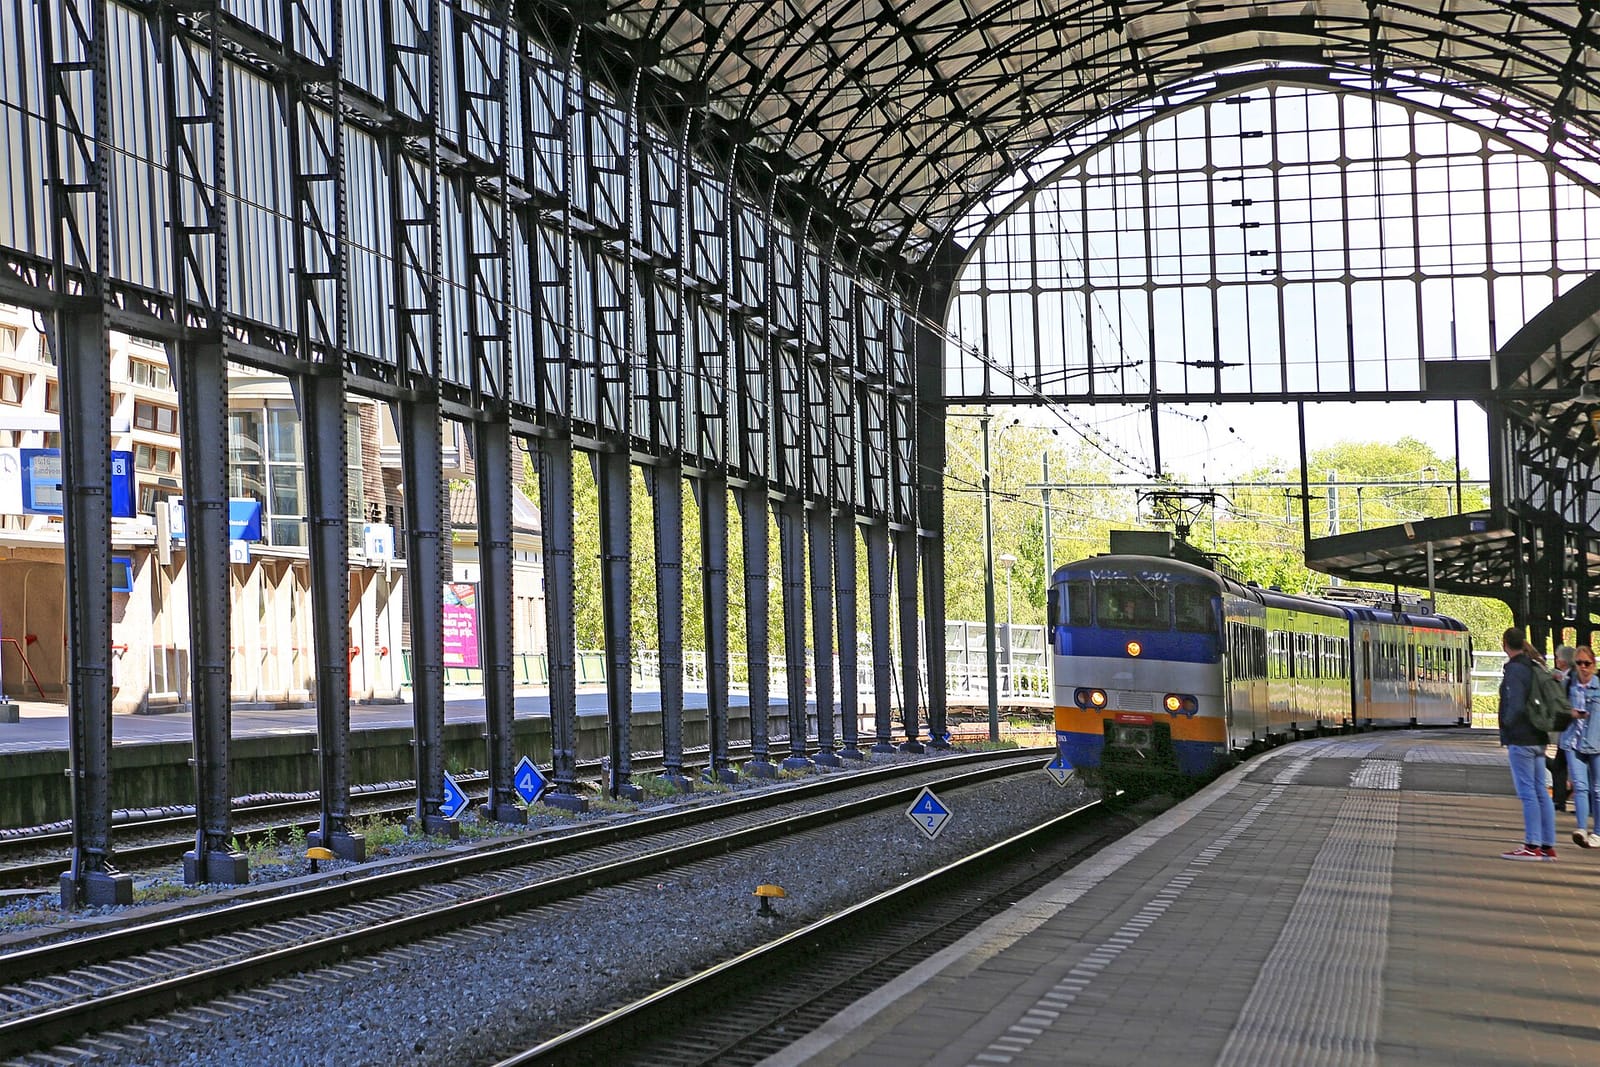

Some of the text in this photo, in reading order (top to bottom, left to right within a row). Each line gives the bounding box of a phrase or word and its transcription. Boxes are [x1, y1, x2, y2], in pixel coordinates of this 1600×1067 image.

[116, 464, 122, 474] 8
[234, 549, 243, 561] D
[1421, 606, 1429, 616] D
[1059, 770, 1065, 779] 3
[519, 773, 534, 793] 4
[924, 800, 933, 812] 4
[926, 816, 934, 828] 2
